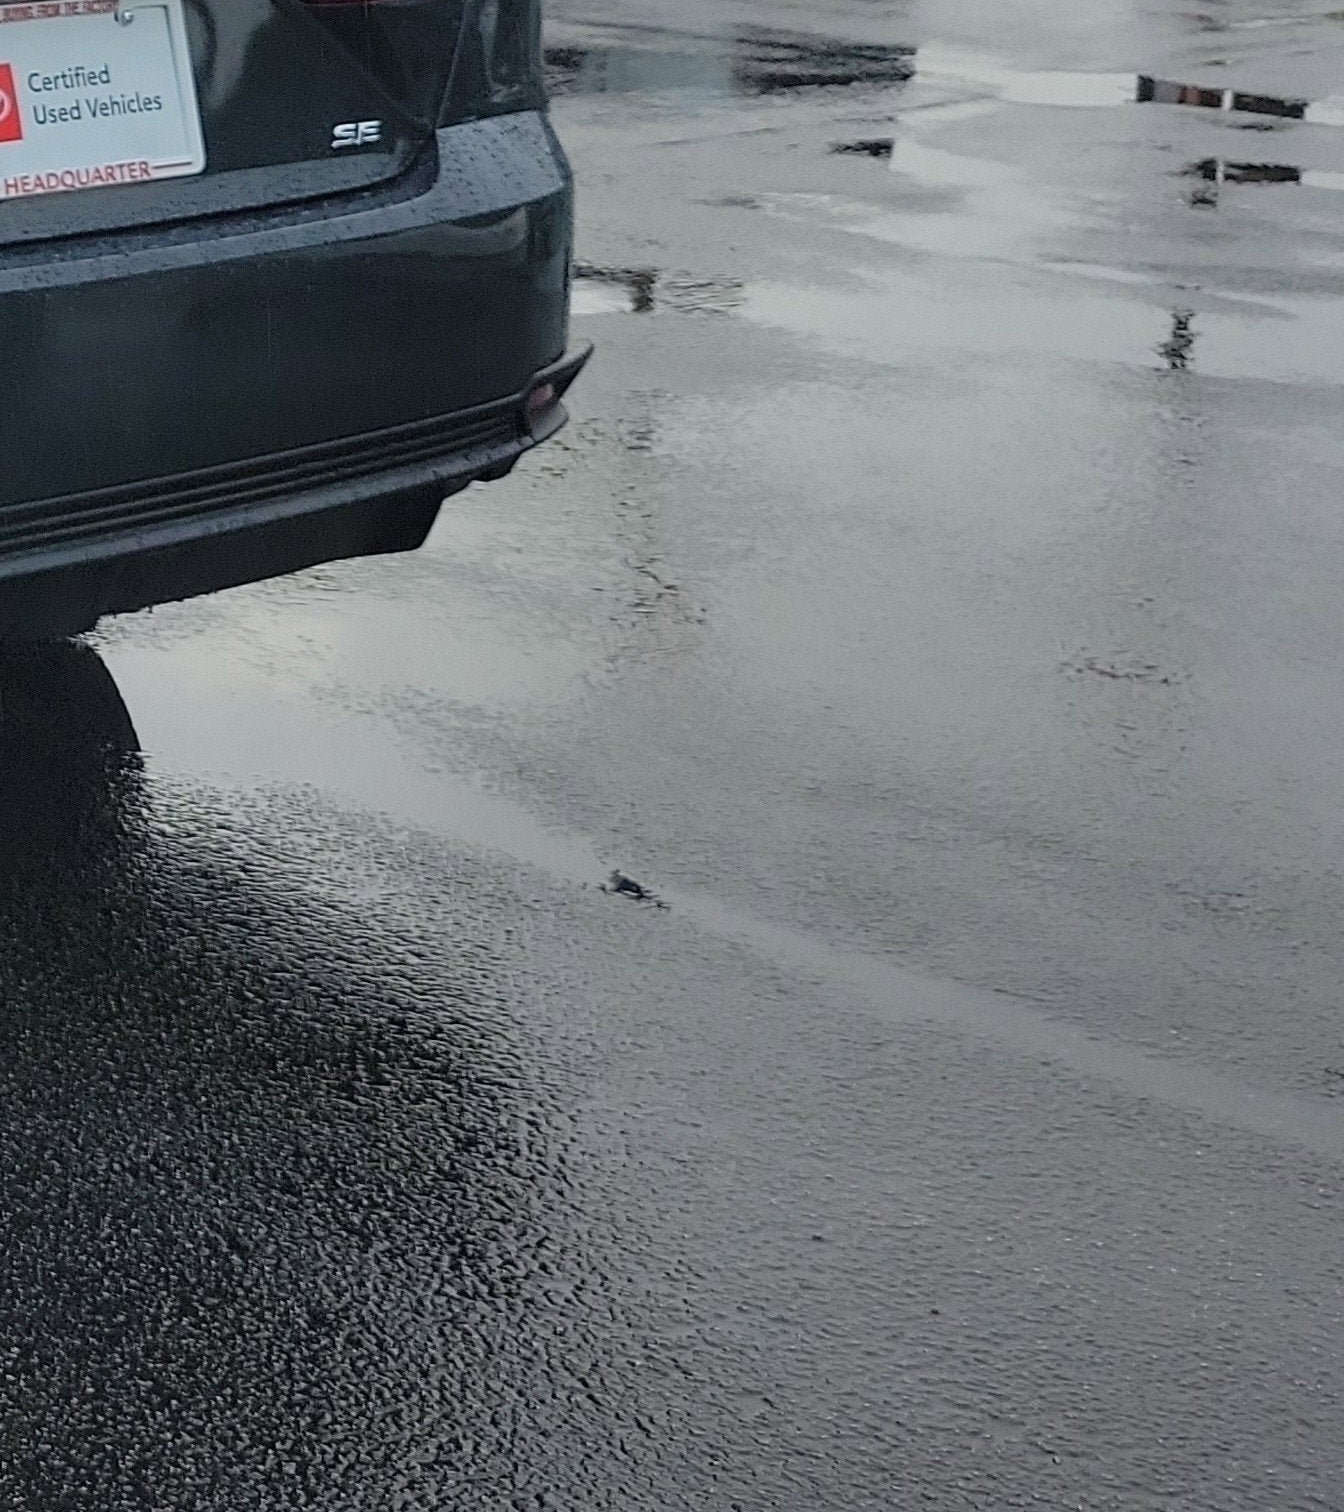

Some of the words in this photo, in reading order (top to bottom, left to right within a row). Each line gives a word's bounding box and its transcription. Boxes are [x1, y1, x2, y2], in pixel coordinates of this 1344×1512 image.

[27, 63, 111, 94] Certified
[32, 101, 82, 125] Used
[86, 92, 163, 120] Vehicles
[331, 120, 383, 148] SE
[4, 161, 151, 195] HEADQUARTER
